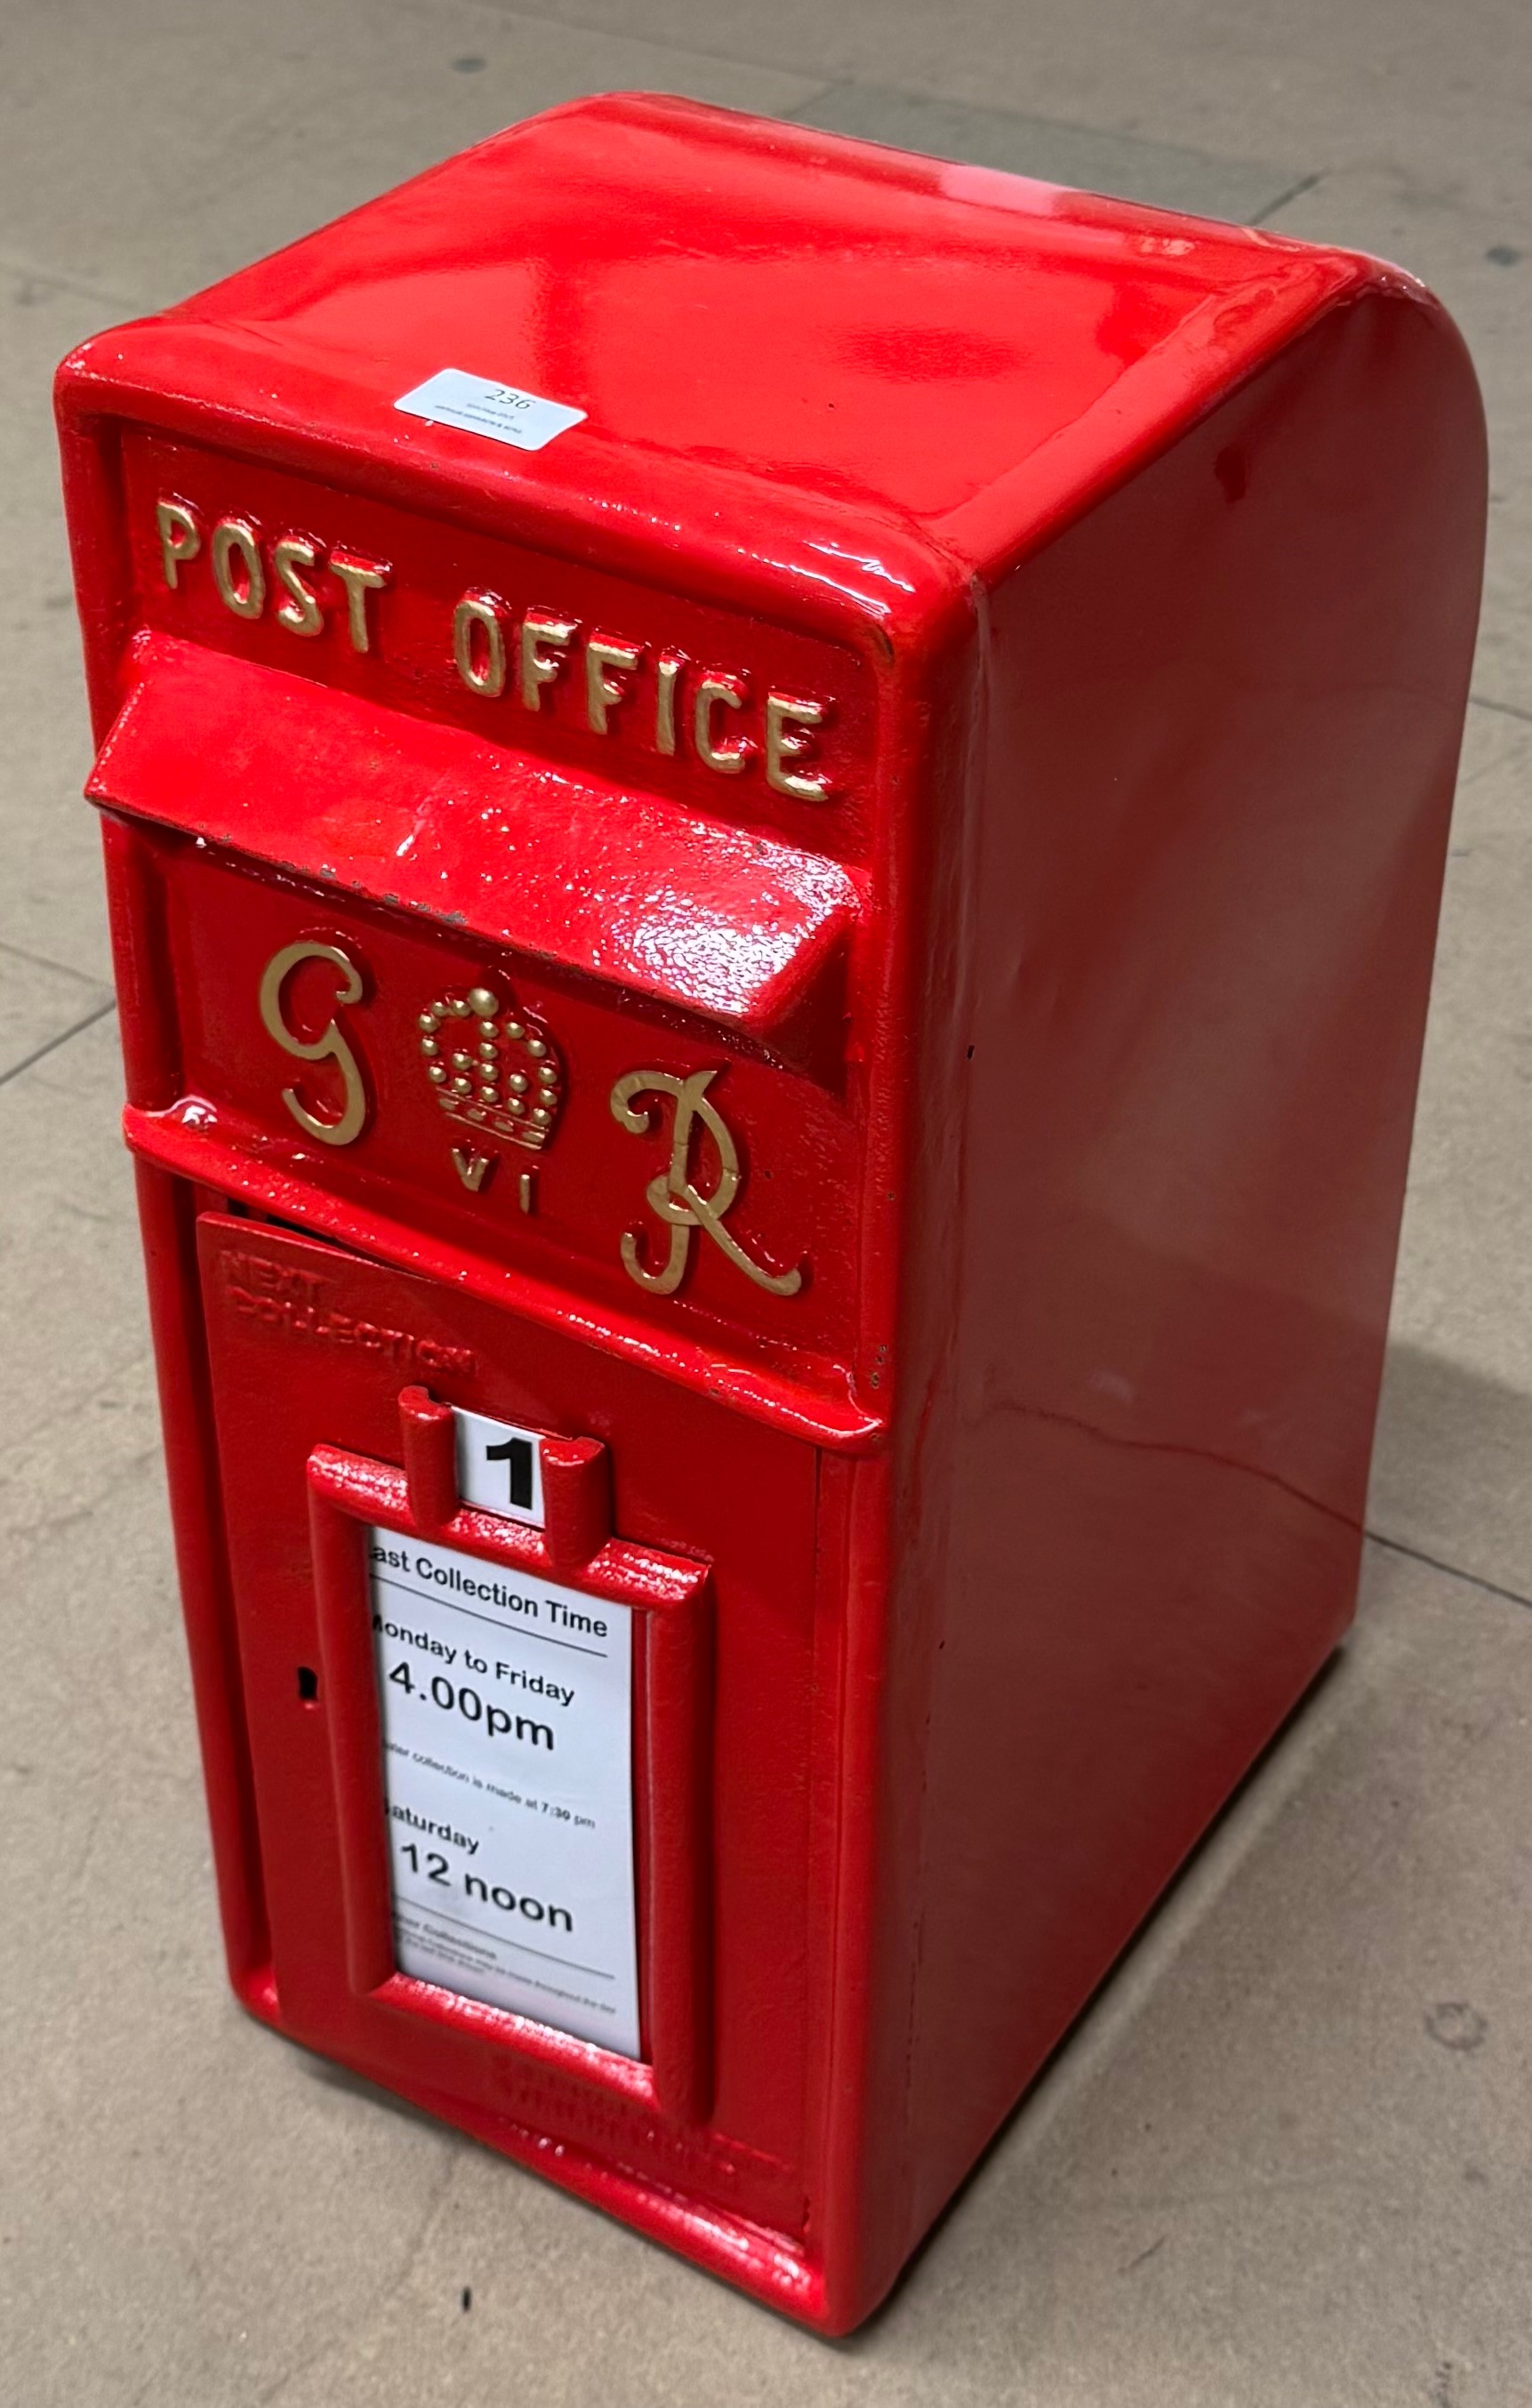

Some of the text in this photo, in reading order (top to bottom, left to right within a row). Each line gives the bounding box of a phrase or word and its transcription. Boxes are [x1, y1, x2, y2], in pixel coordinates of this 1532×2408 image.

[485, 389, 536, 409] 236
[157, 498, 830, 801] POST OFFICE
[259, 940, 802, 1296] G R
[485, 1437, 533, 1510] 1
[370, 1546, 607, 1636] ast Collection Time
[389, 1662, 554, 1750] 4.00pm
[464, 1649, 487, 1674] to
[495, 1661, 574, 1706] Friday
[385, 1800, 479, 1855] aturday
[486, 1782, 521, 1804] made
[541, 1802, 570, 1821] 7:30
[574, 1815, 596, 1829] pm
[401, 1843, 573, 1931] 12 noon
